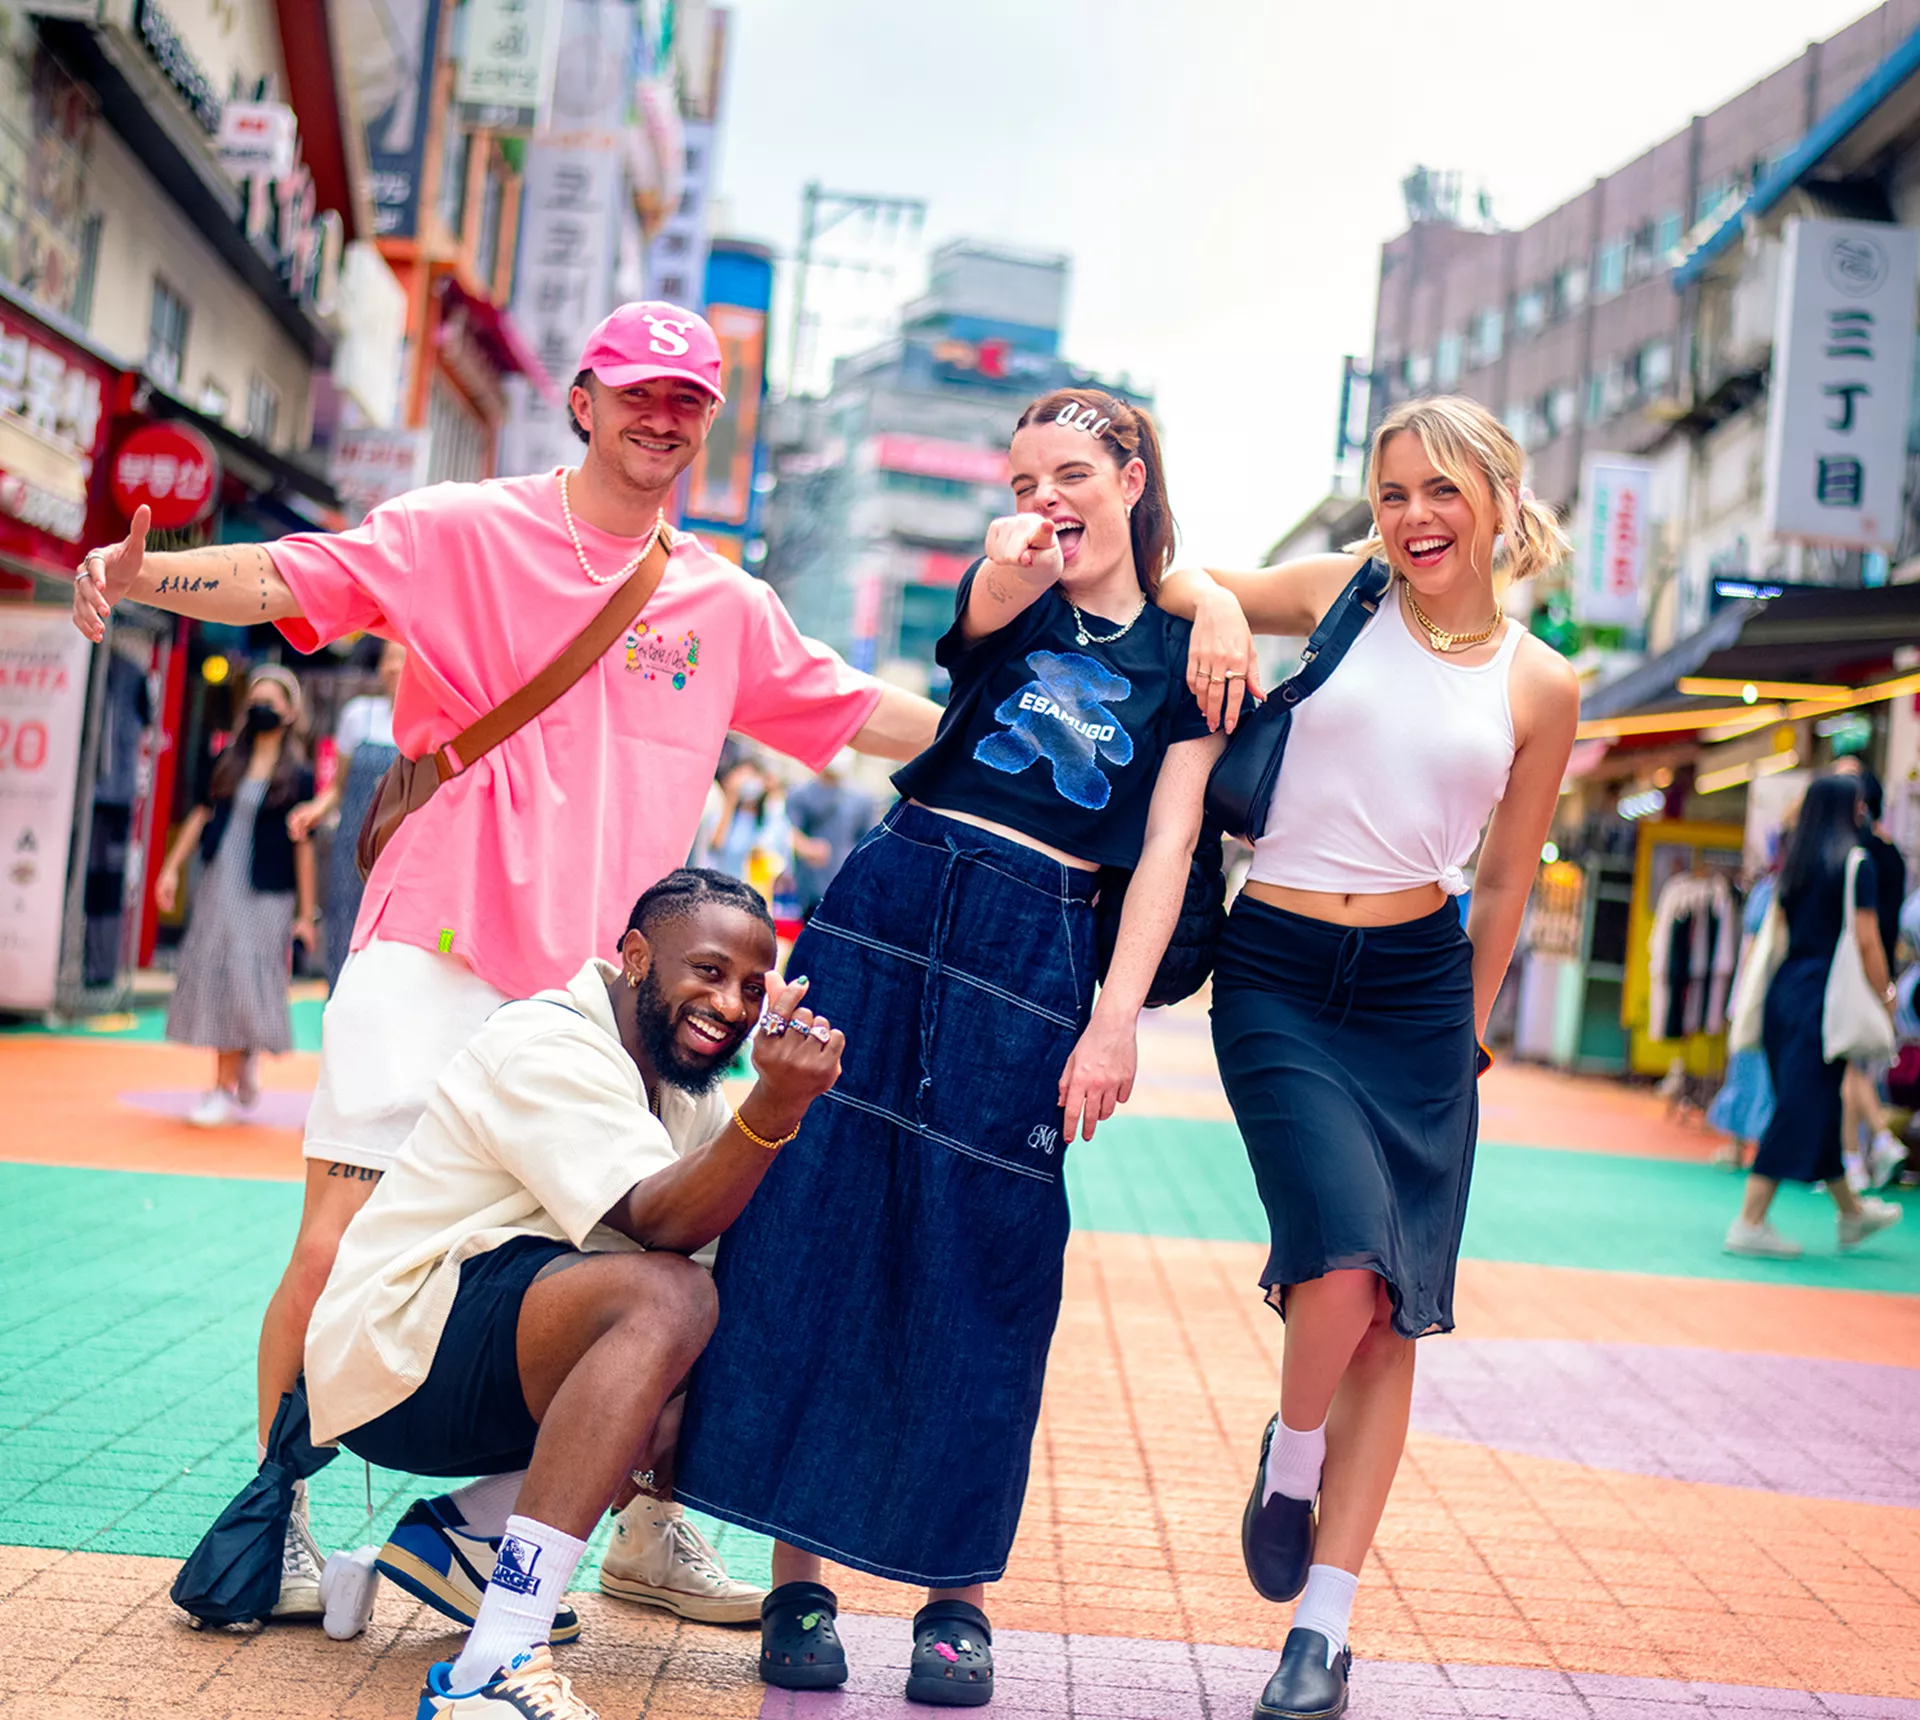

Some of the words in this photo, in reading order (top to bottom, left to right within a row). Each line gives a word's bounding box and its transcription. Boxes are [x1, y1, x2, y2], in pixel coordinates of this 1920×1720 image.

[642, 314, 695, 354] S
[1816, 309, 1876, 509] 三丁目
[118, 453, 206, 500] 부동산
[1019, 691, 1116, 742] ESAMUGO
